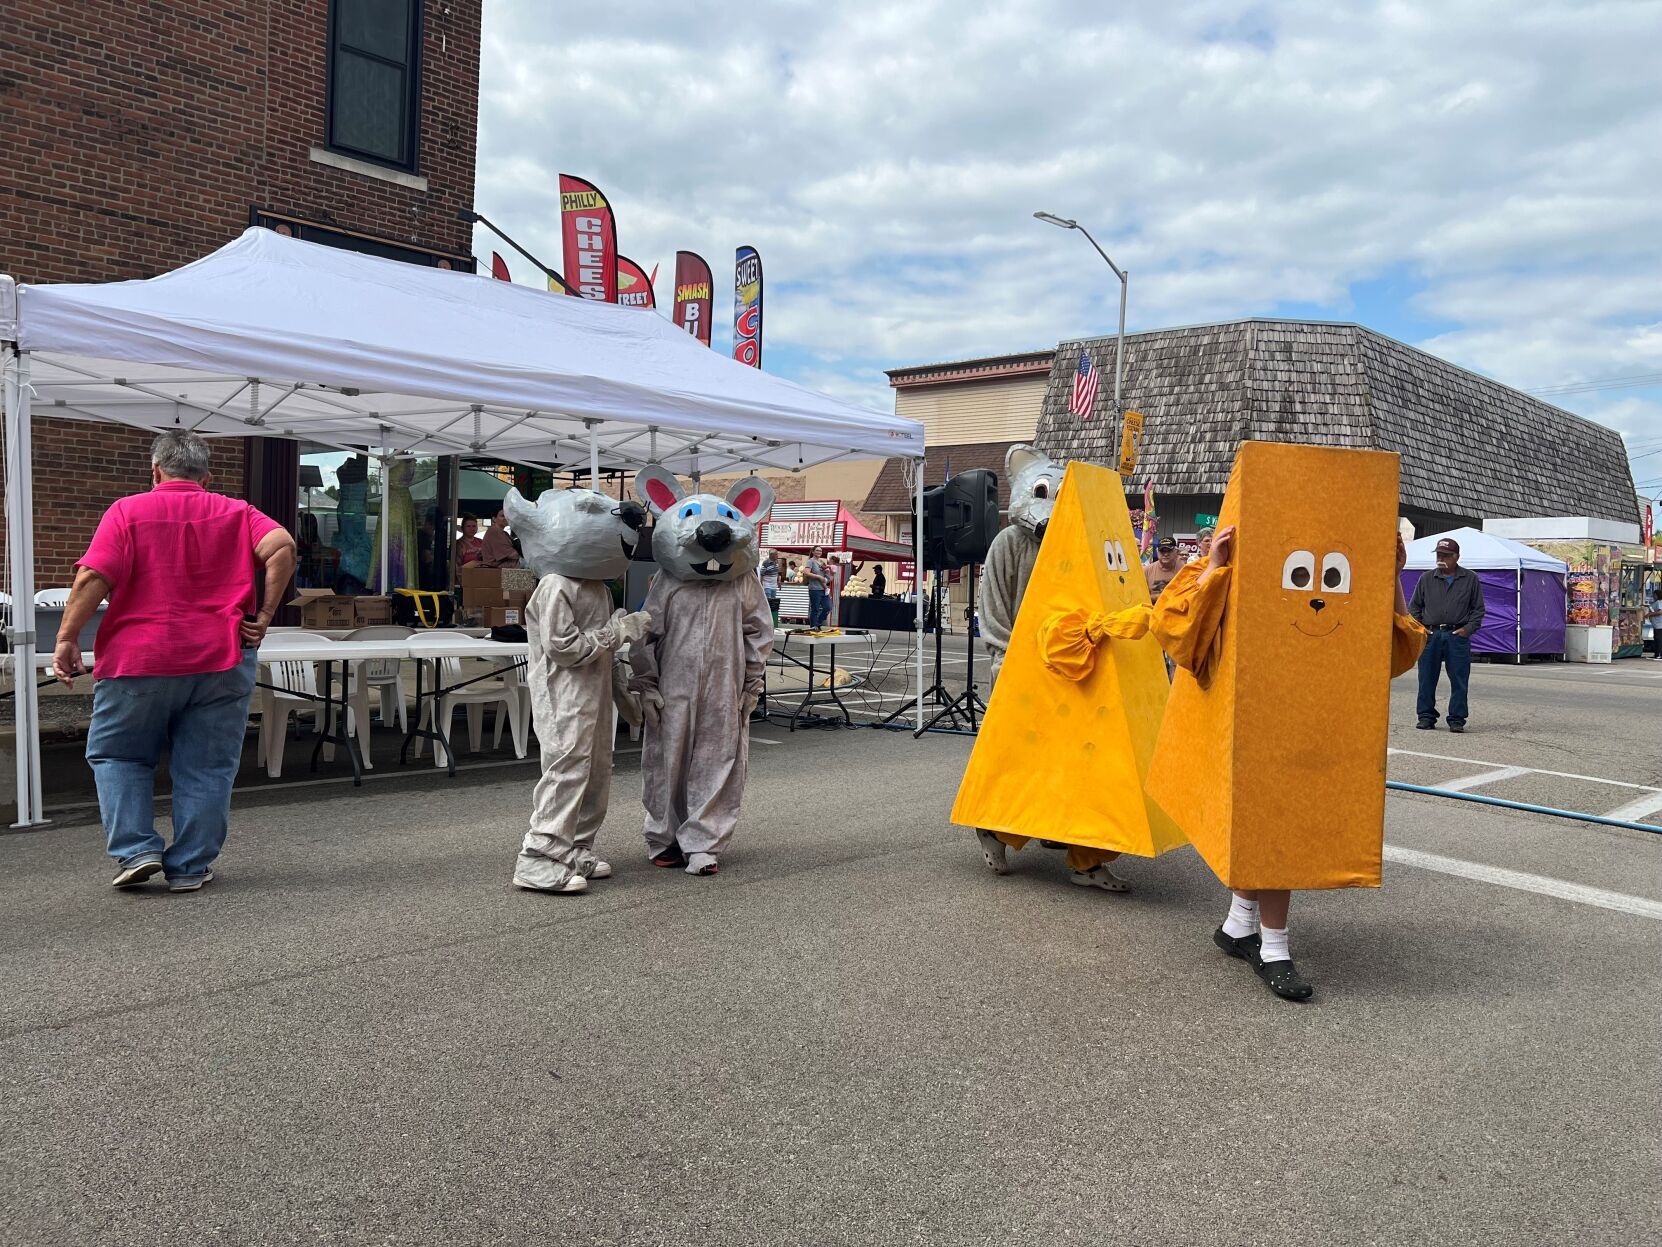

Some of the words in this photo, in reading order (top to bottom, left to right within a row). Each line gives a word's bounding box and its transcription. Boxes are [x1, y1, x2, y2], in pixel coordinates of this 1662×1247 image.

[562, 192, 597, 210] PHILLY
[575, 216, 606, 300] CHEES
[736, 258, 758, 287] SWEET
[618, 292, 648, 305] TREET
[678, 282, 709, 303] SMASH
[1205, 516, 1211, 525] S
